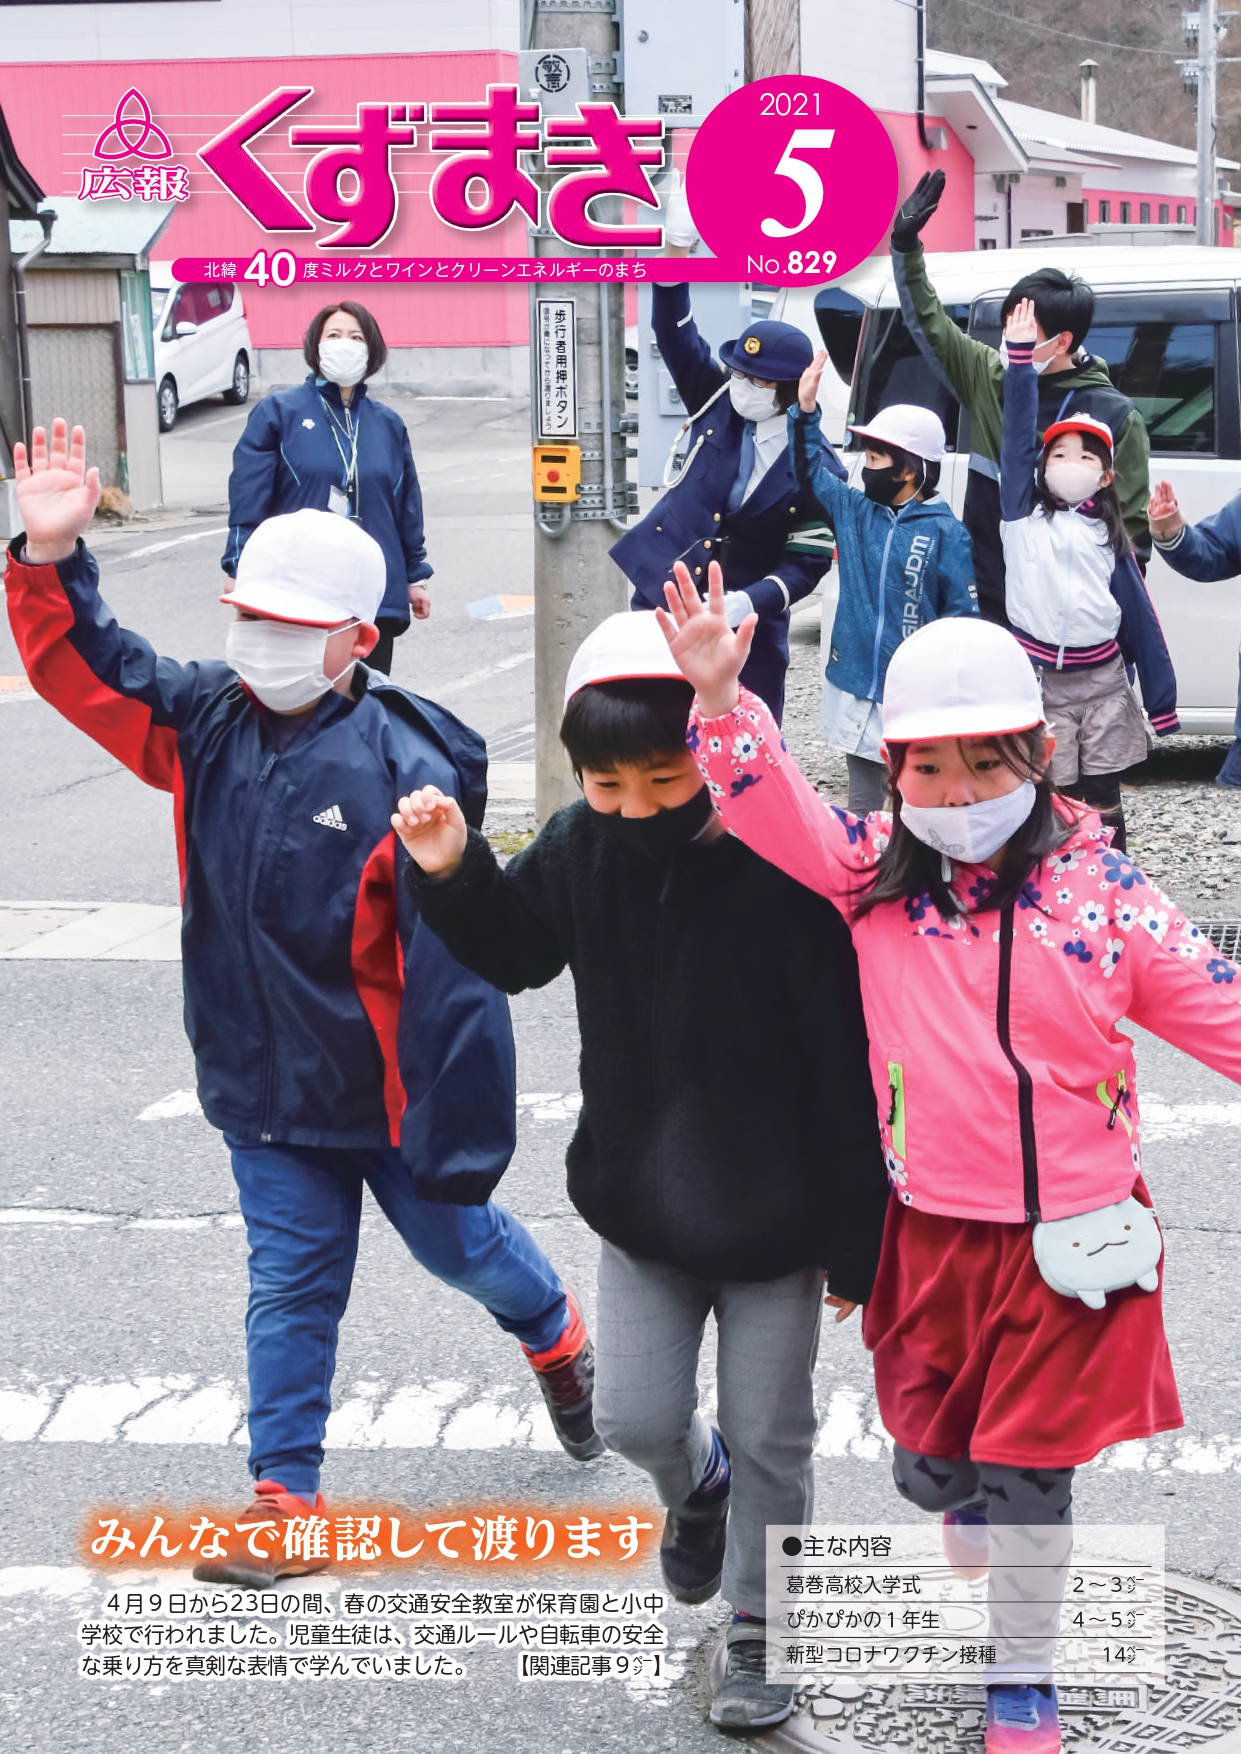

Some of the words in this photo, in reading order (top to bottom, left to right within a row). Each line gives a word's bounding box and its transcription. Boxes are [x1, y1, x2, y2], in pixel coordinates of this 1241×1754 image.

[554, 309, 568, 429] 歩行者用押ボタン
[312, 814, 348, 832] adidas
